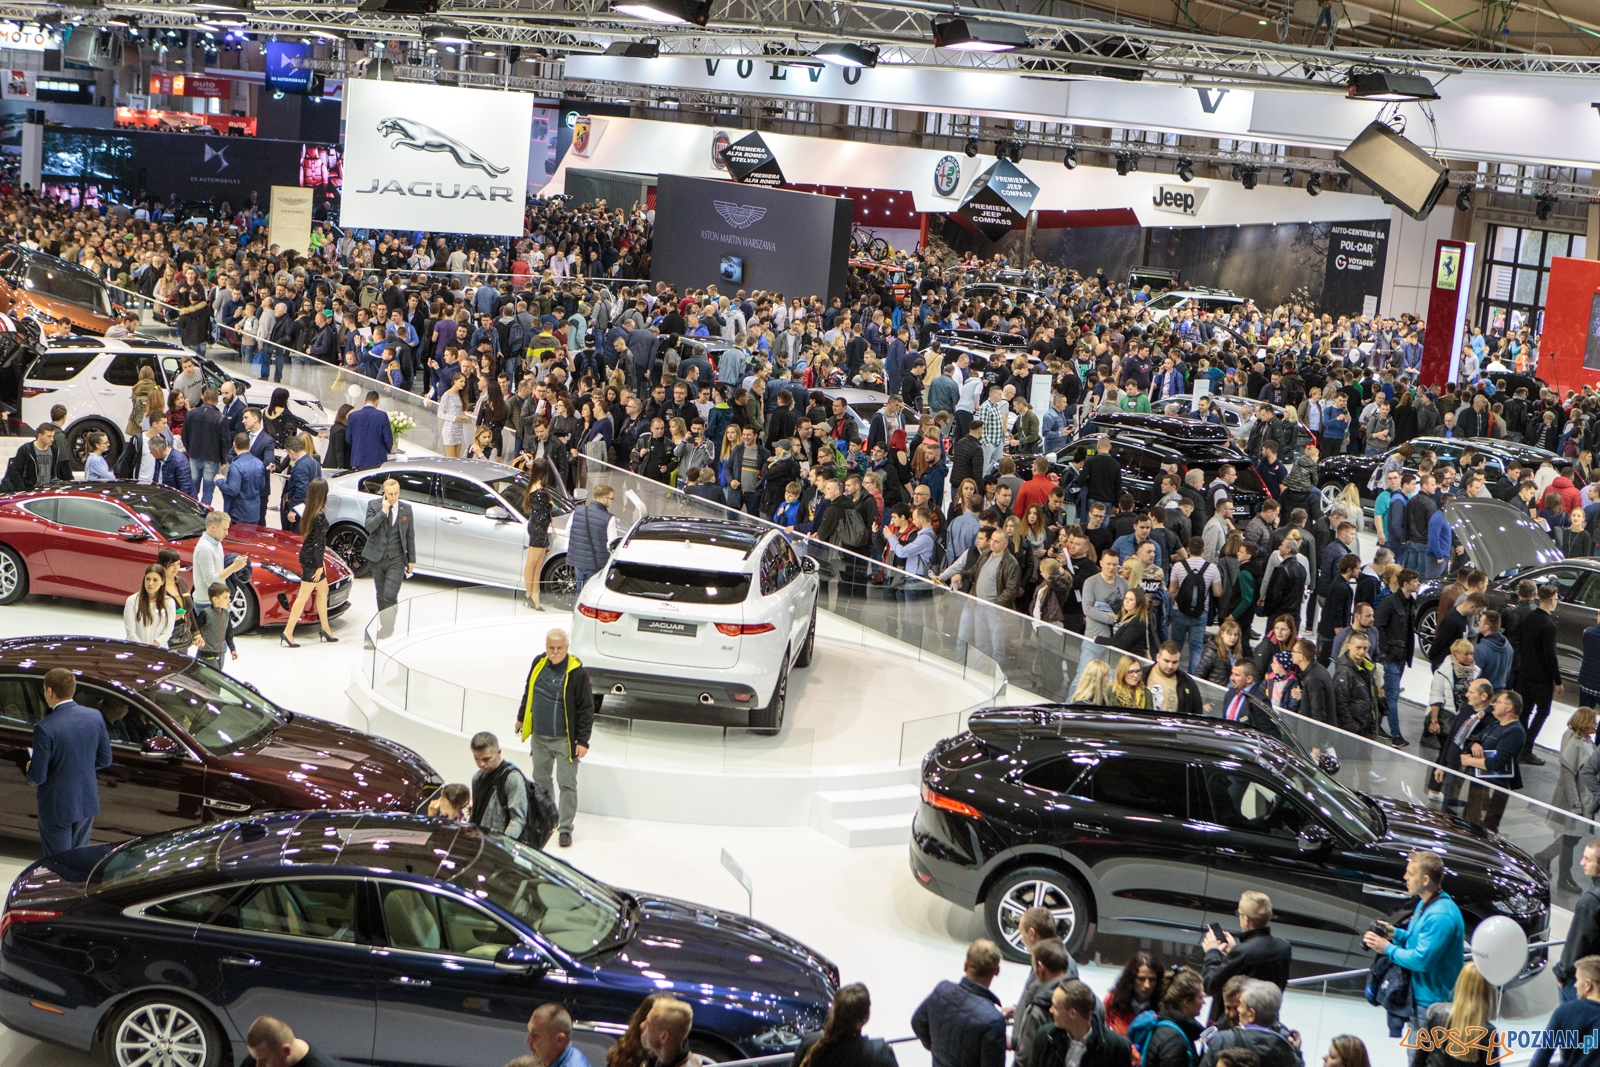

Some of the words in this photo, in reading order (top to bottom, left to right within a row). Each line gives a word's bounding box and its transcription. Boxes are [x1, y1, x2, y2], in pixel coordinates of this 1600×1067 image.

[705, 58, 862, 86] VOLVO
[193, 80, 216, 88] auto
[732, 145, 766, 153] PREMIERA
[730, 156, 759, 164] STELVIO
[199, 176, 241, 185] AUTOMOBILES
[750, 172, 780, 180] PREMIERA
[995, 175, 1029, 185] PREMIERA
[356, 178, 514, 203] JAGUAR
[1001, 189, 1033, 198] COMPASS
[1152, 186, 1195, 213] Jeep
[969, 202, 1013, 213] PREMIERA
[981, 210, 1002, 218] JEEP
[972, 216, 1012, 226] COMPASS
[1331, 226, 1376, 239] AUTO-CENTRUM
[1376, 231, 1385, 240] SA
[700, 229, 720, 242] ASTON
[720, 233, 742, 245] MARTIN
[742, 237, 776, 252] WARSZAWA
[1340, 240, 1374, 254] POL-CAR
[1348, 257, 1374, 267] VOYAGER
[649, 621, 685, 631] JAGUAR
